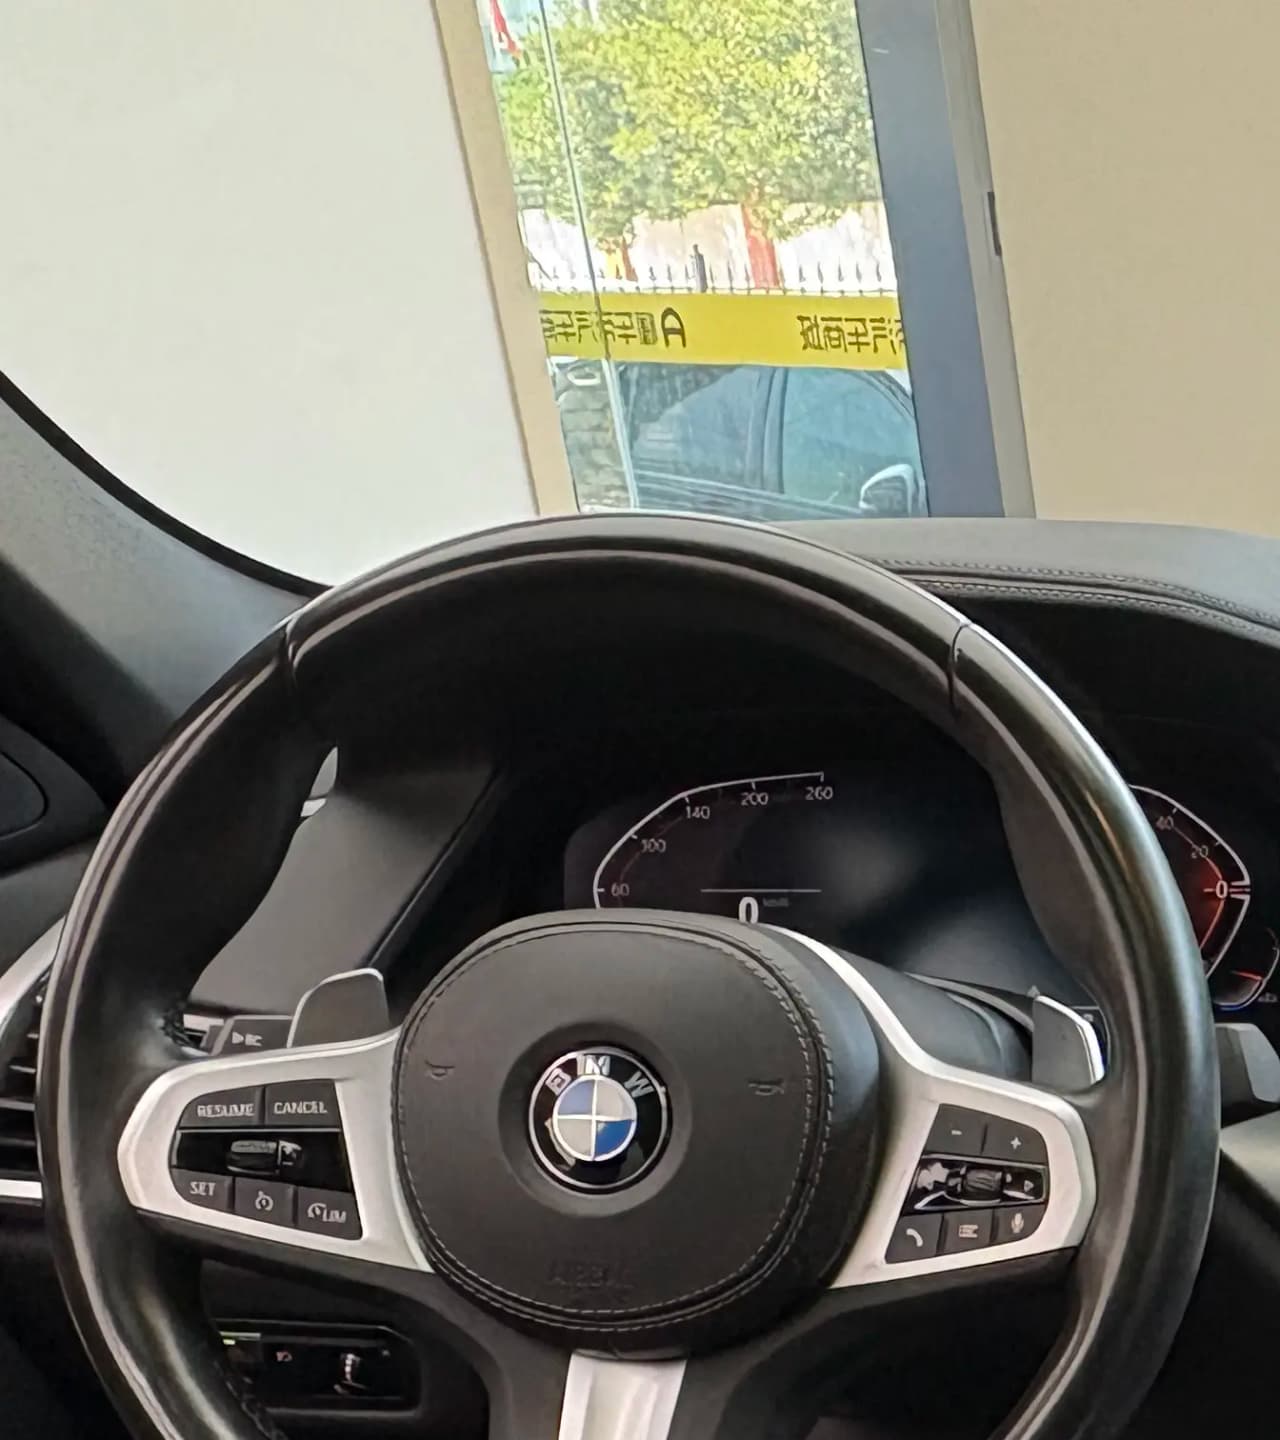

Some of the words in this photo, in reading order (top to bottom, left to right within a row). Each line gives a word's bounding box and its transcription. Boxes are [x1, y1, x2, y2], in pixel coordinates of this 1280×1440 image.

[741, 792, 769, 806] 200
[685, 805, 711, 819] 140
[611, 883, 630, 897] 60
[738, 897, 760, 925] 0
[545, 1054, 656, 1100] BMW
[196, 1103, 255, 1118] RESUME
[273, 1100, 328, 1115] CANCEL
[190, 1181, 217, 1196] SET
